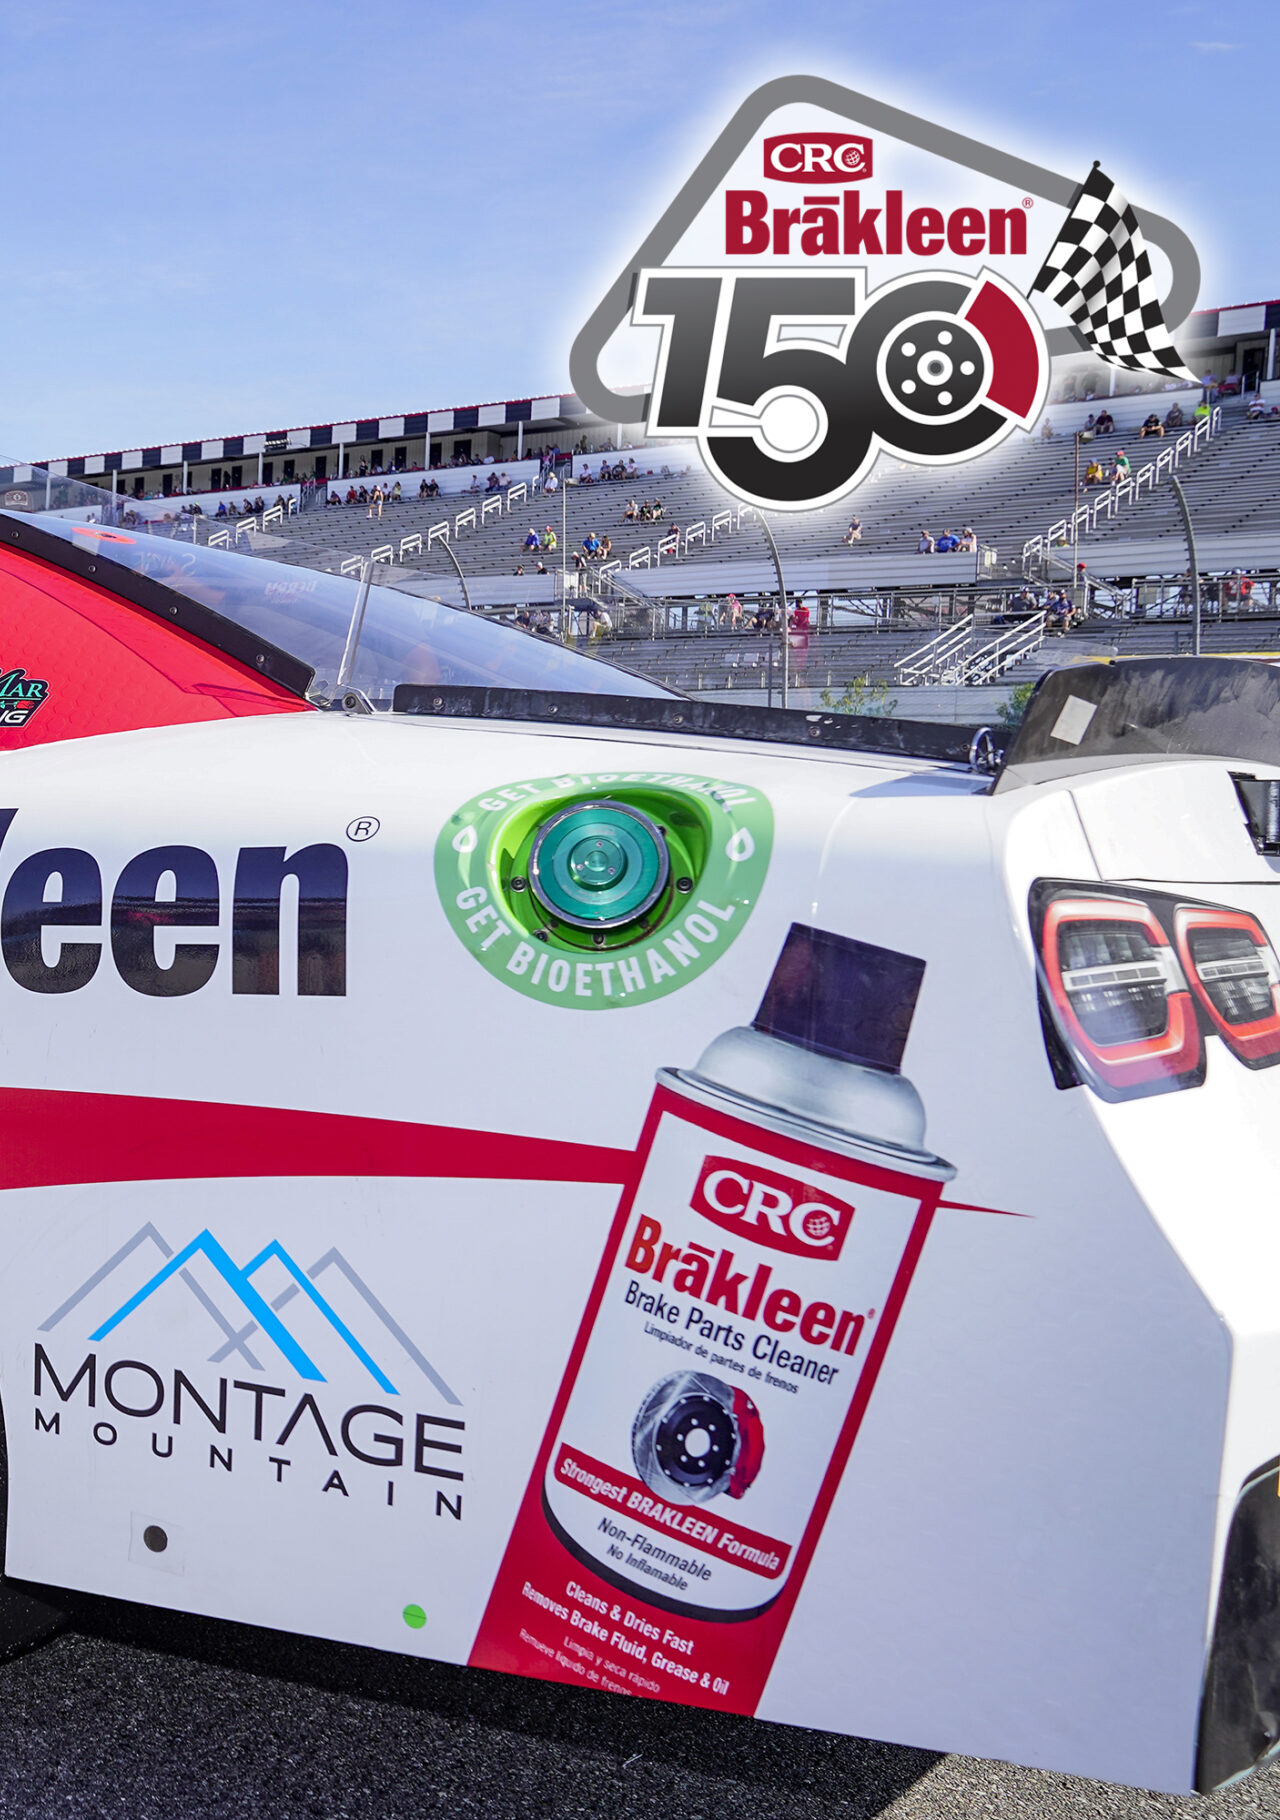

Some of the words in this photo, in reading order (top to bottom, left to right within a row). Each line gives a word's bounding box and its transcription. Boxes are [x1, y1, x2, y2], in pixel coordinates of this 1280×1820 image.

[477, 783, 542, 813] GET
[456, 886, 512, 950] GET
[555, 898, 735, 998] BIOETHANOL
[703, 1169, 841, 1247] CRC
[624, 1213, 867, 1357] Brākleen
[624, 1279, 680, 1324] Brake
[685, 1306, 746, 1353] Parts
[752, 1334, 840, 1386] Cleaner
[643, 1321, 693, 1354] Limpiador
[694, 1344, 710, 1359] de
[709, 1351, 746, 1375] partes
[747, 1366, 763, 1381] de
[764, 1372, 799, 1395] frenos
[34, 1342, 466, 1482] MONTAGE
[34, 1407, 463, 1521] MOUNTAIN
[560, 1458, 628, 1504] Strongest
[626, 1491, 719, 1546] BRAKLEEN
[717, 1532, 781, 1572] Formula
[597, 1516, 713, 1583] Non-Flammable
[606, 1543, 624, 1562] No
[625, 1550, 689, 1592] Inflamable
[519, 1627, 555, 1658] Remueve
[586, 1668, 600, 1683] de
[521, 1581, 570, 1621] Removes
[569, 1609, 609, 1642] Brake
[609, 1631, 648, 1665] Fluid,
[651, 1651, 699, 1684] Grease
[699, 1672, 711, 1690] &
[712, 1677, 731, 1696] Oil
[565, 1581, 609, 1615] Cleans
[609, 1604, 622, 1622] &
[622, 1610, 661, 1641] Dries
[661, 1629, 695, 1656] Fast
[563, 1635, 595, 1661] Limpia
[595, 1656, 603, 1666] y
[603, 1659, 627, 1678] seca
[628, 1670, 661, 1693] rápido
